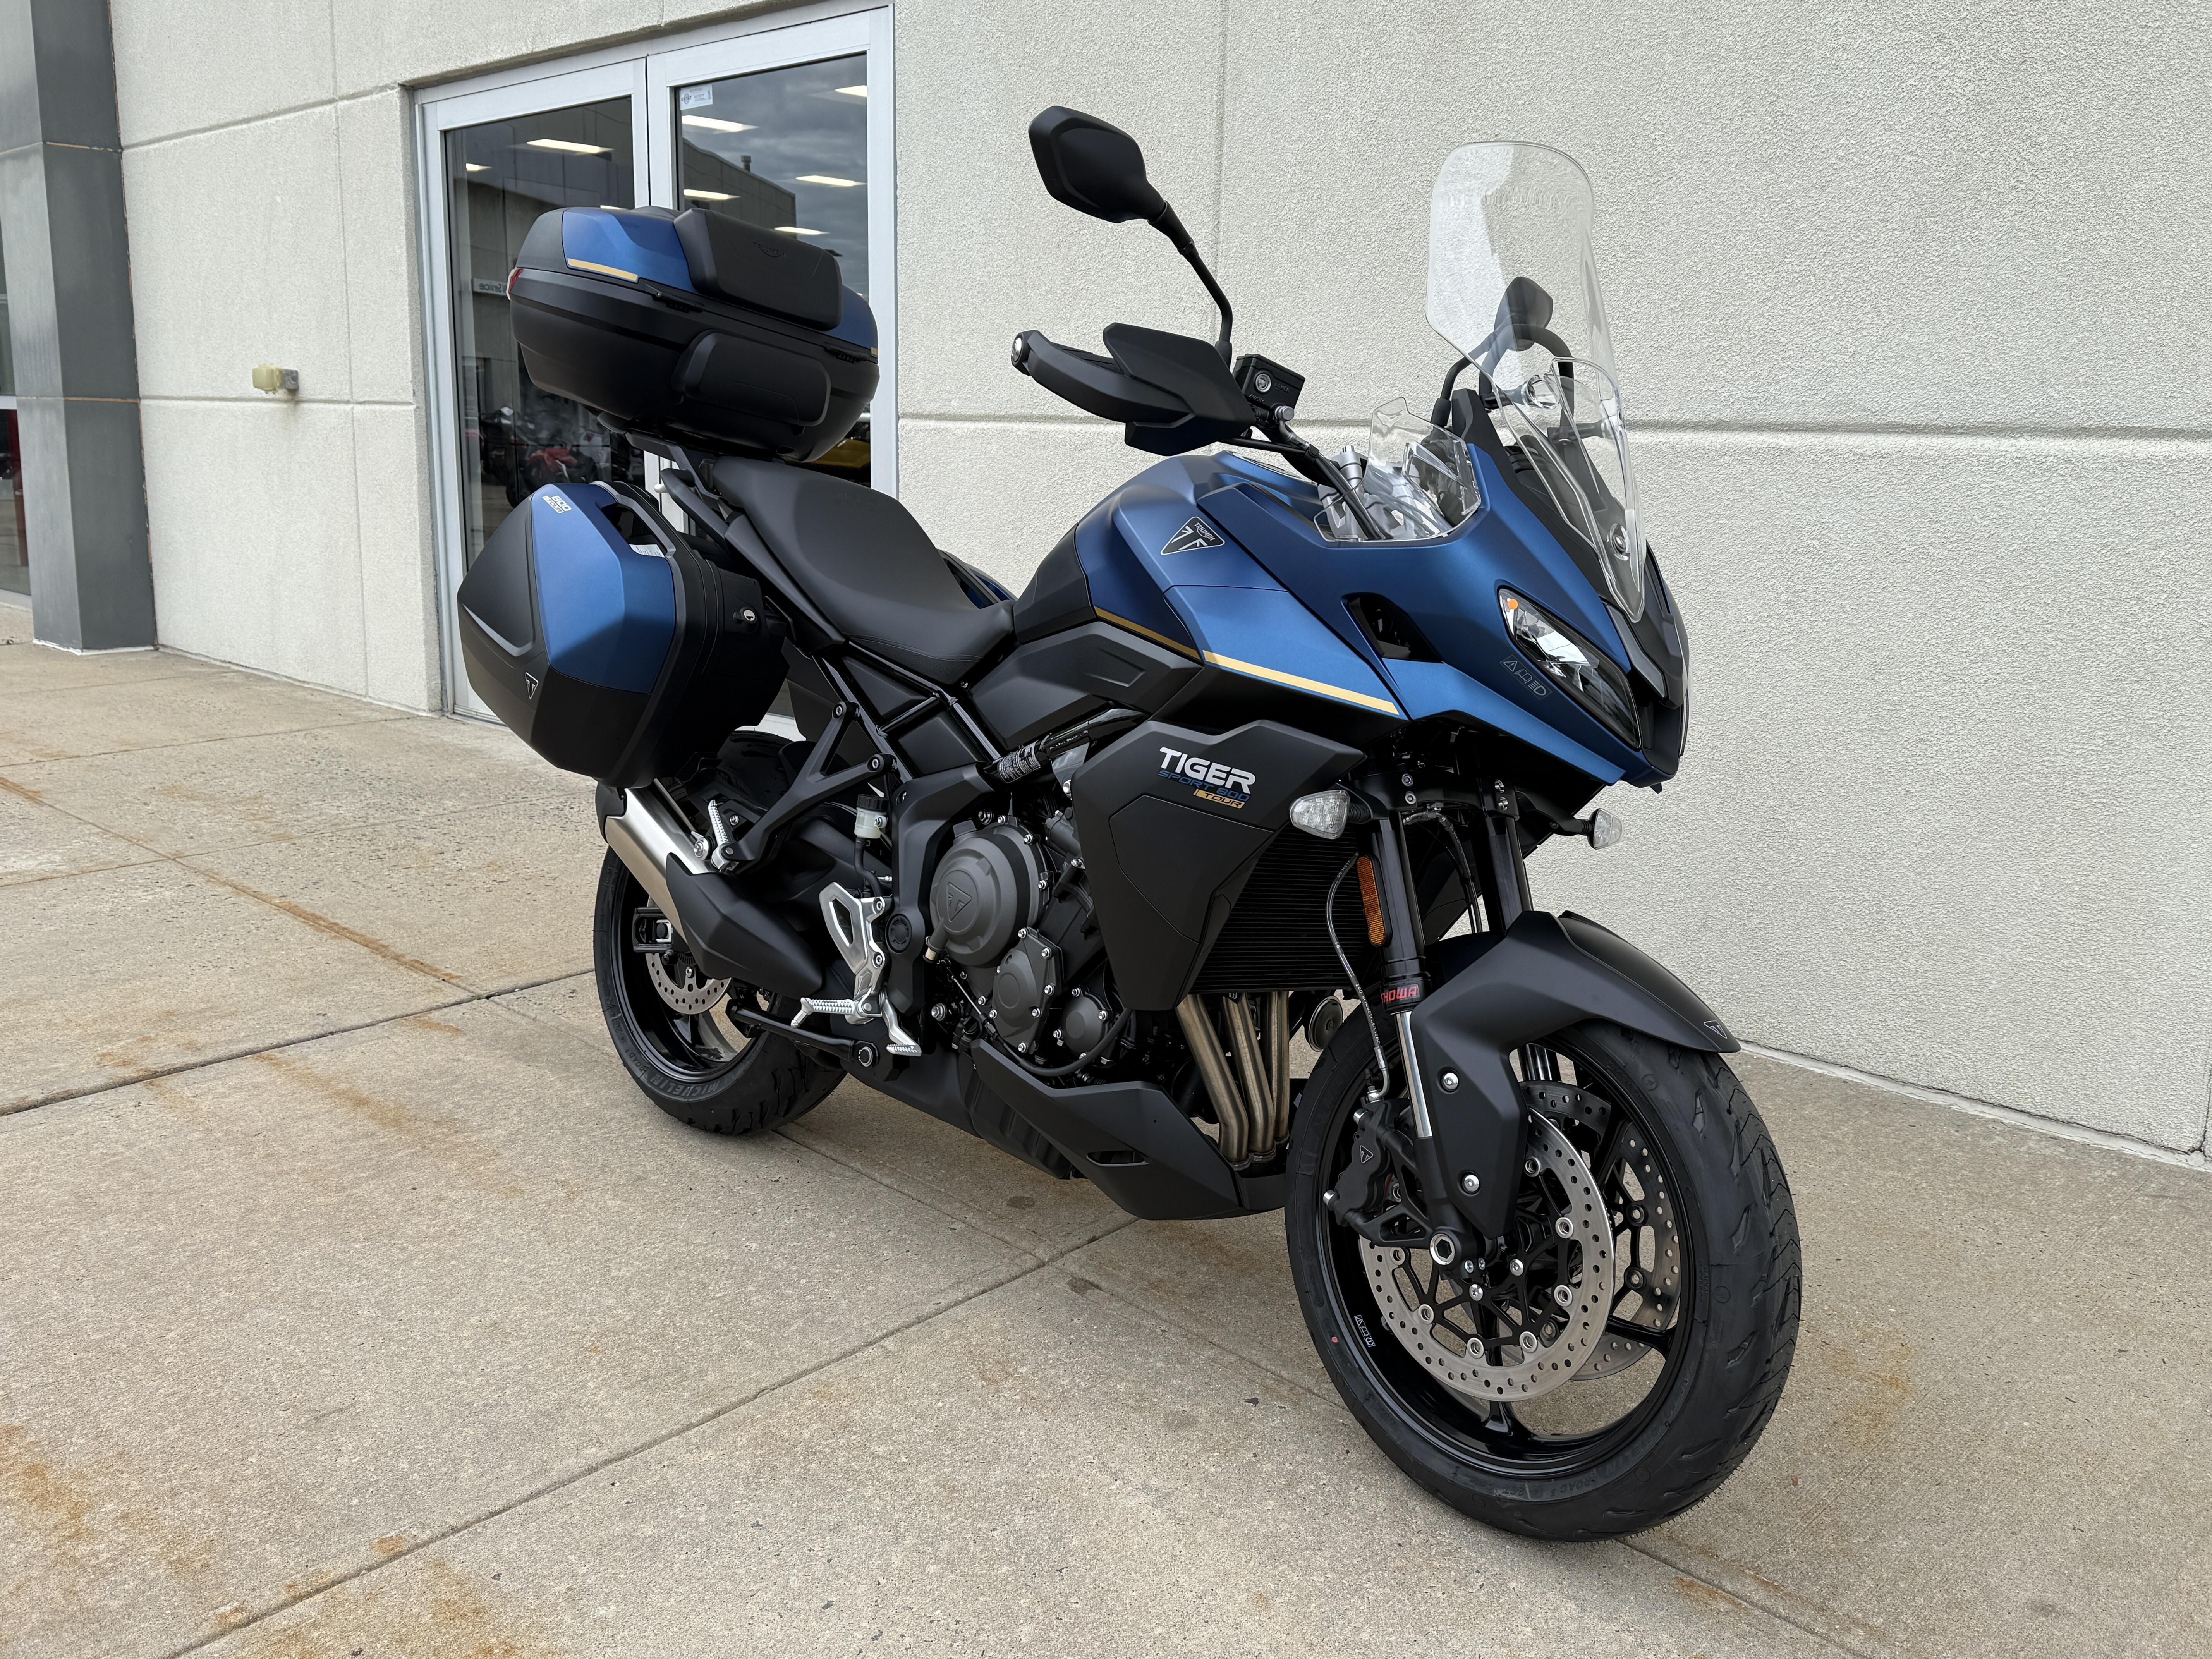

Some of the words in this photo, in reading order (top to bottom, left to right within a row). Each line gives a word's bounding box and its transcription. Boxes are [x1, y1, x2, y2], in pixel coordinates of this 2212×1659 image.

[551, 495, 572, 512] 800
[1194, 522, 1215, 541] TRIUMPH
[1159, 747, 1255, 794] TIGER
[1158, 770, 1214, 790] SPORT
[1216, 787, 1250, 802] 800
[1204, 792, 1242, 807] TOUR
[650, 1073, 720, 1097] MICHELIN
[1560, 1478, 1592, 1490] ROAD
